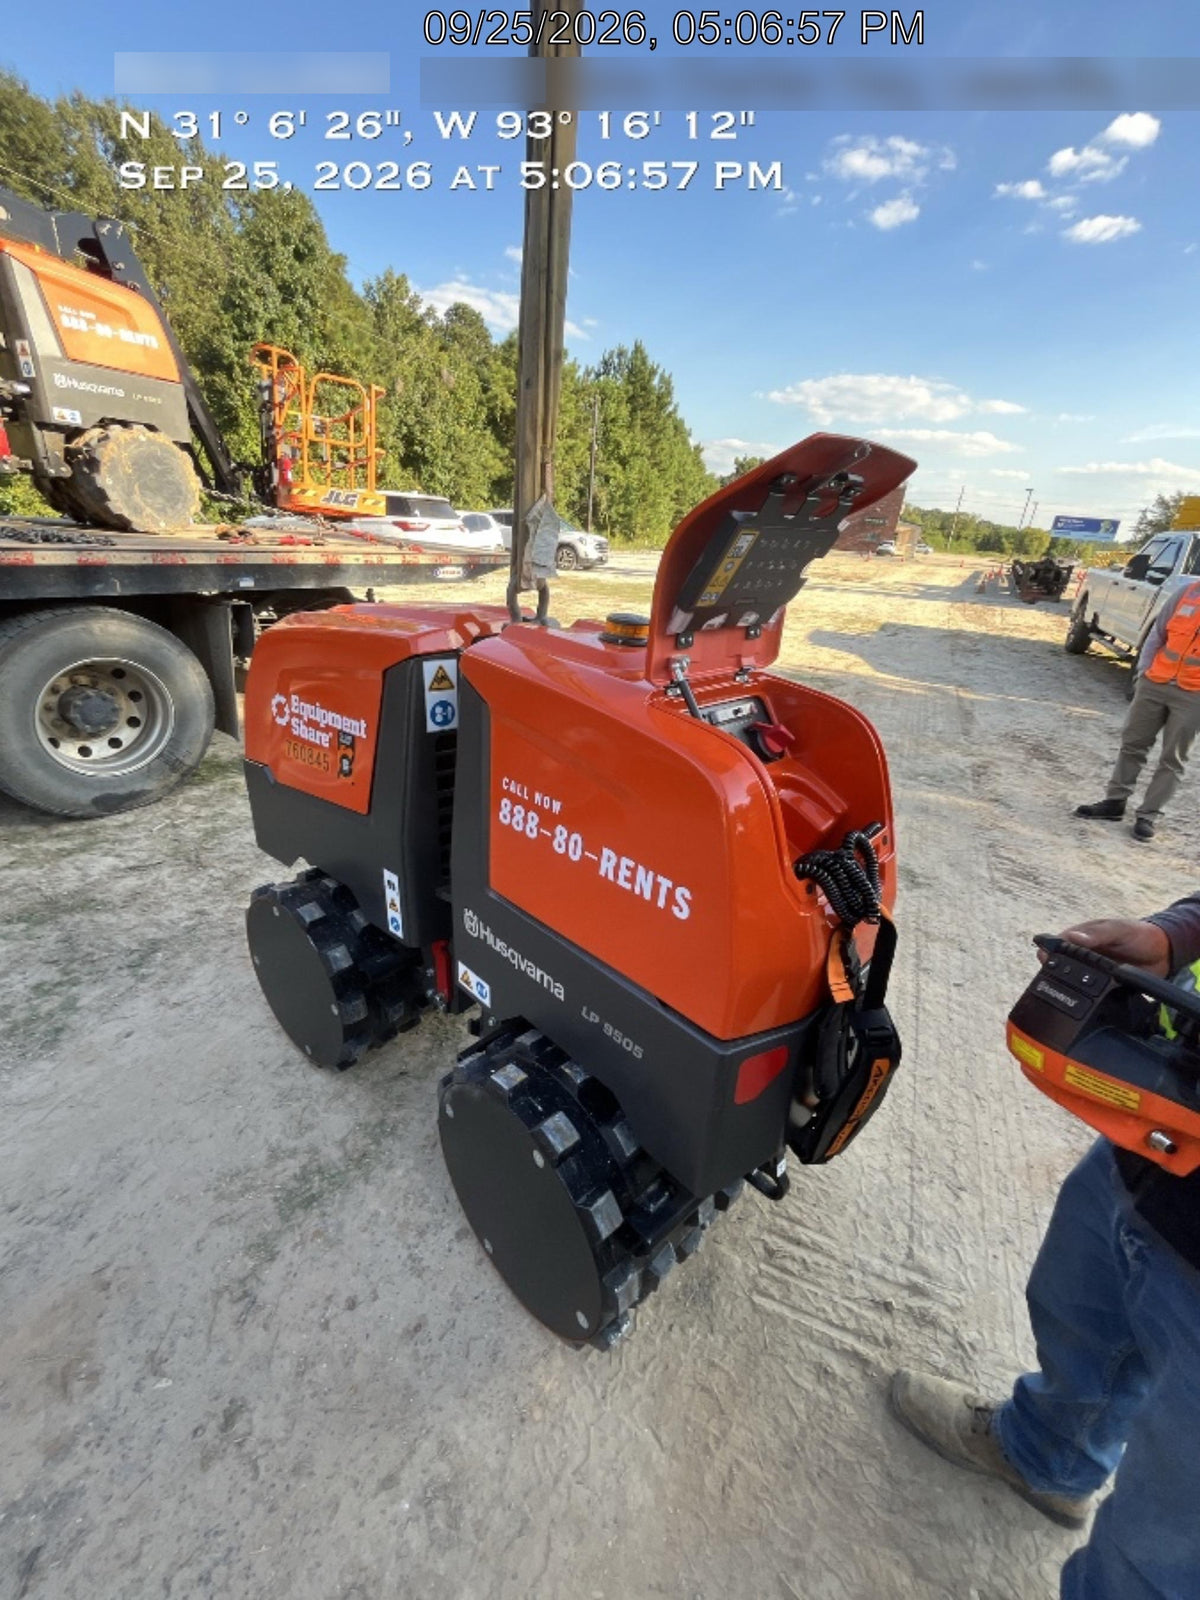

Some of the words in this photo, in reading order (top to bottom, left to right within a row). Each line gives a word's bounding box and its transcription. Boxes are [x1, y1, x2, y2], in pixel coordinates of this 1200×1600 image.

[321, 489, 359, 508] JLG
[290, 693, 367, 739] Equipment
[290, 716, 331, 749] Share
[285, 739, 331, 773] 760845
[502, 775, 530, 801] CALL
[534, 791, 562, 815] NOW
[498, 797, 693, 921] 888-80-RENTS
[479, 919, 566, 1003] Husqvarna
[580, 1005, 601, 1024] LP
[602, 1022, 645, 1060] 9505
